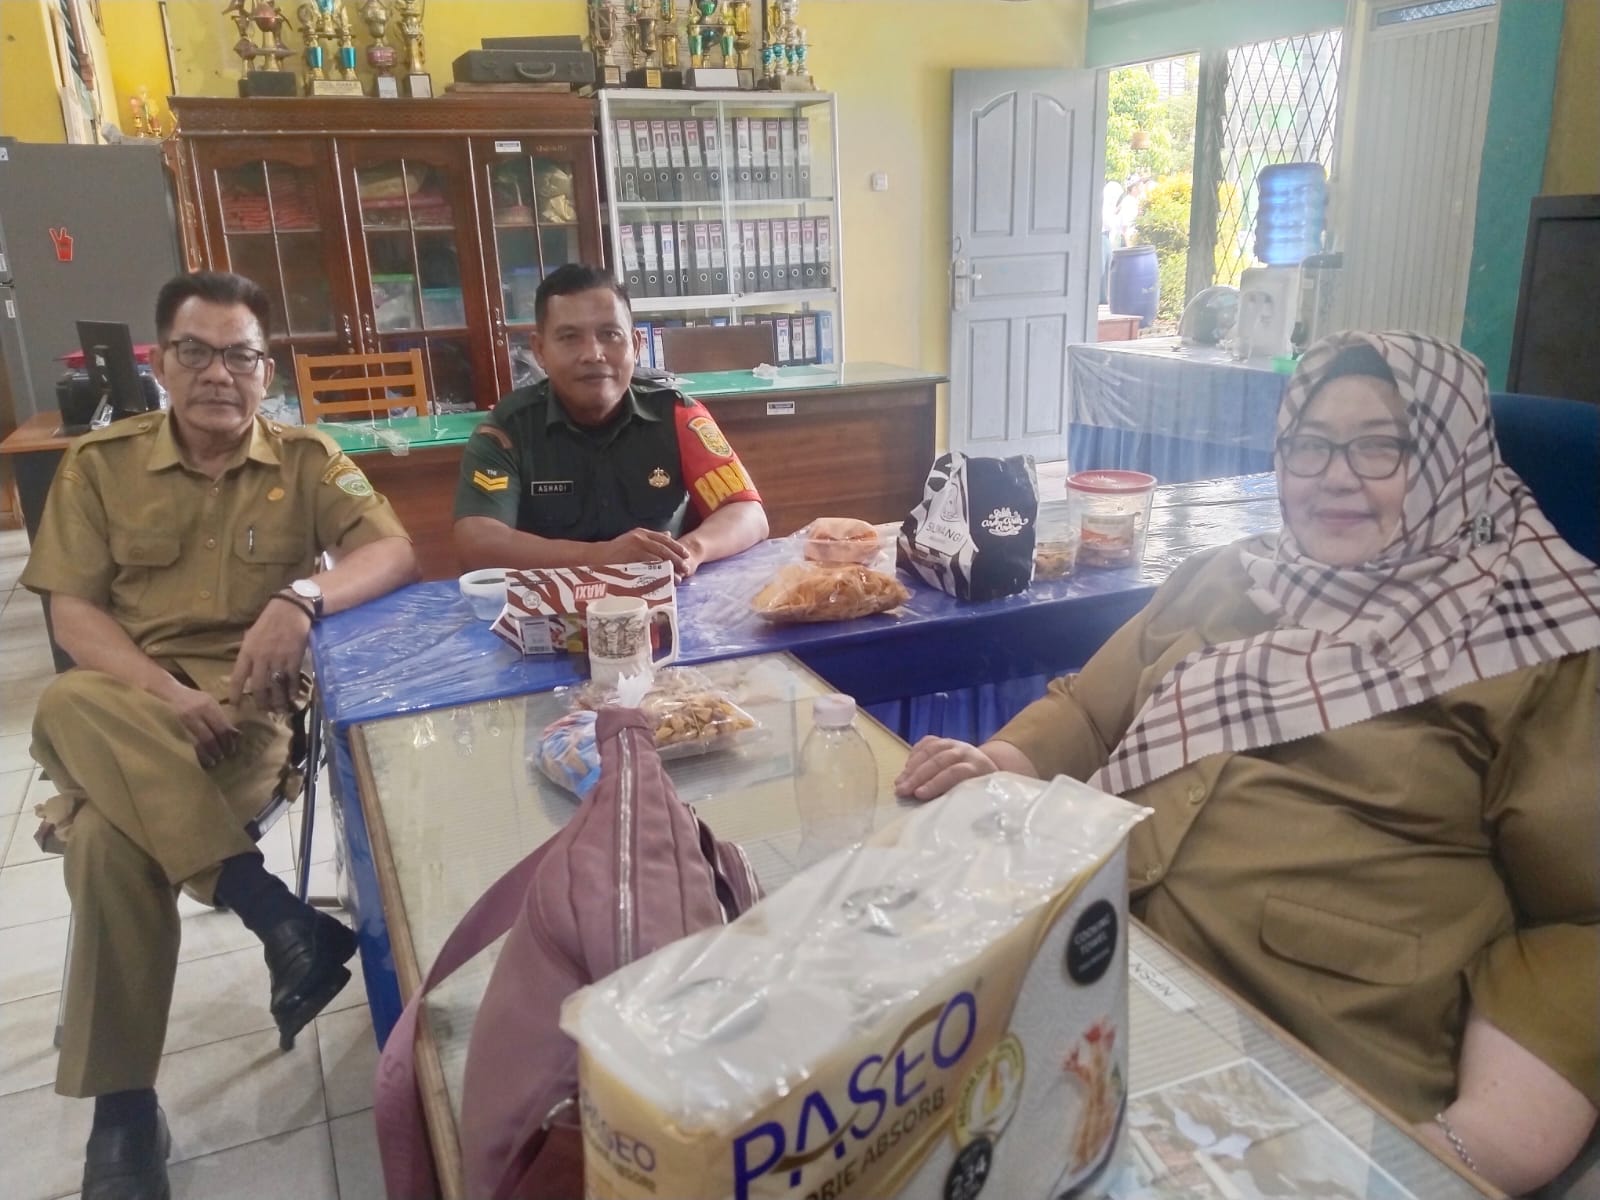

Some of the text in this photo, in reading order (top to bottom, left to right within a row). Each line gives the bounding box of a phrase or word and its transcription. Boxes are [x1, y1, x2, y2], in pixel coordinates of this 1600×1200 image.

[575, 583, 607, 600] MAXI
[733, 990, 976, 1200] PASEO
[861, 1086, 946, 1173] ABSORB
